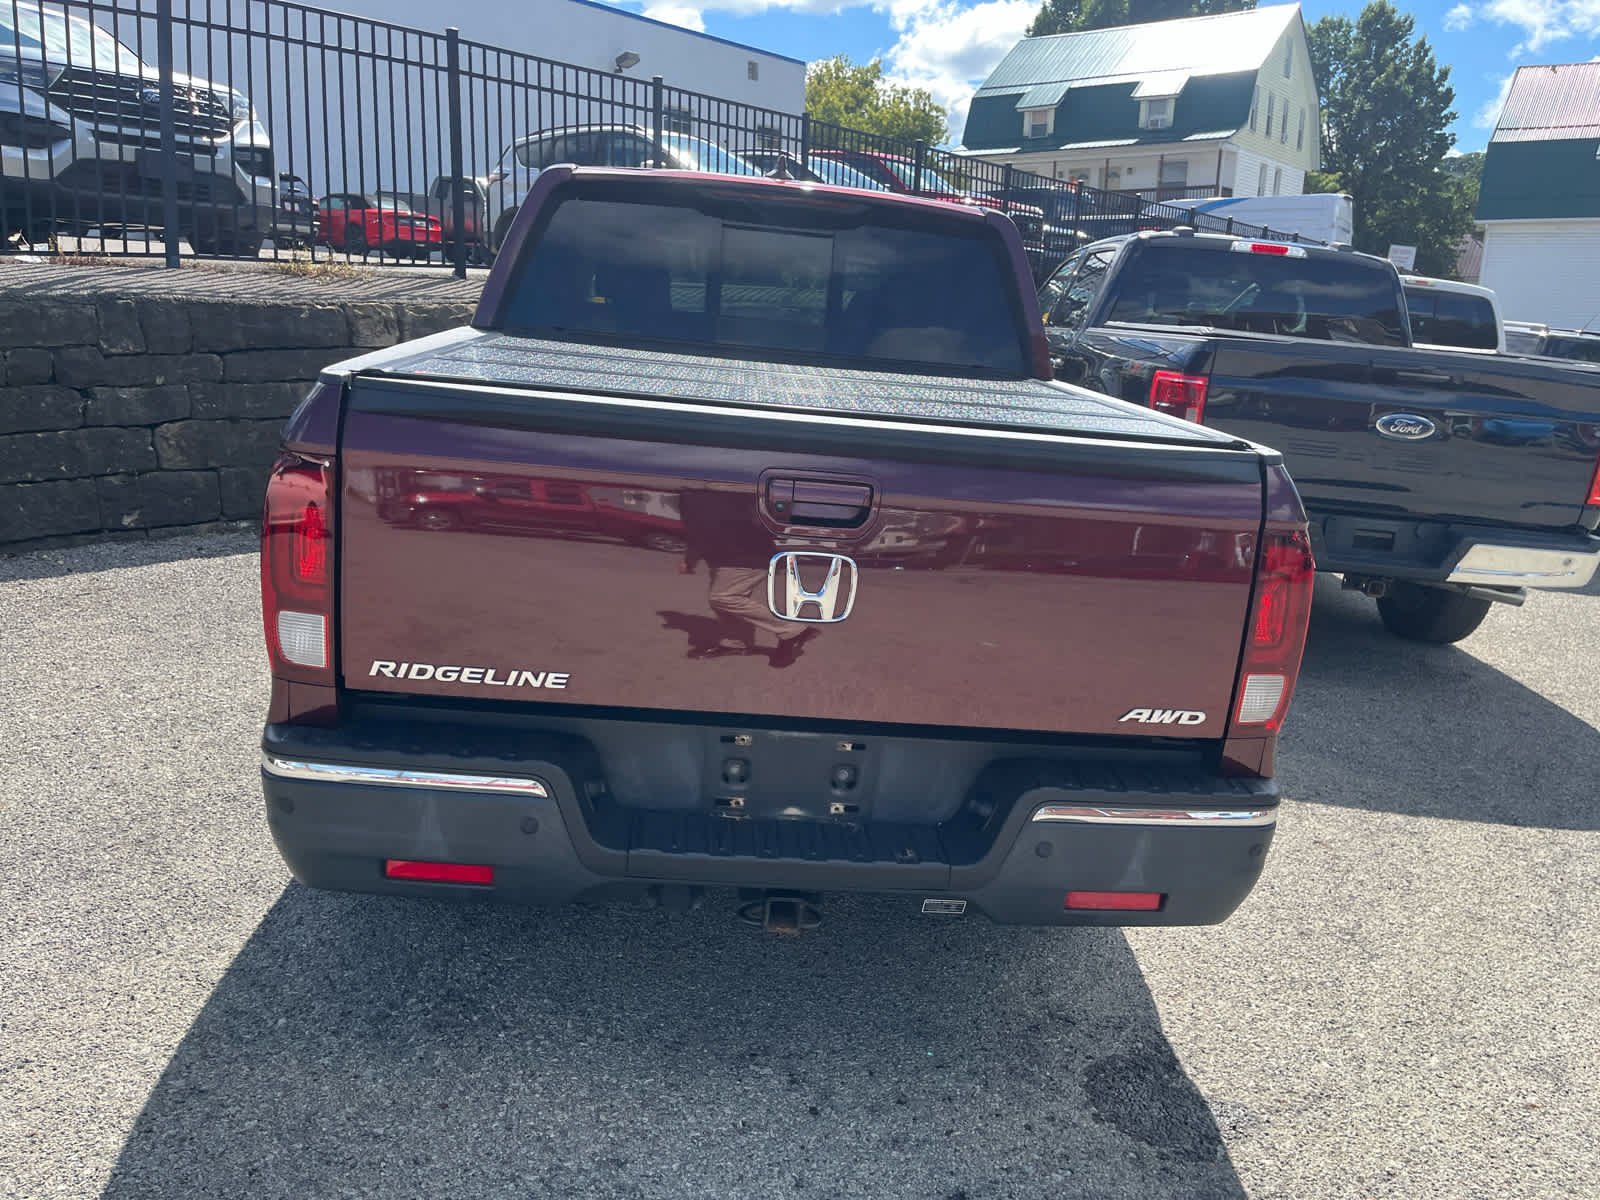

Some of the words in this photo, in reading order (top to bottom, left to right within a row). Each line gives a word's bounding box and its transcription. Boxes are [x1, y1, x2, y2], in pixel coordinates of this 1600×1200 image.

[1390, 418, 1424, 435] Ford
[368, 660, 570, 689] RIDGELINE
[1117, 707, 1207, 725] AWD
